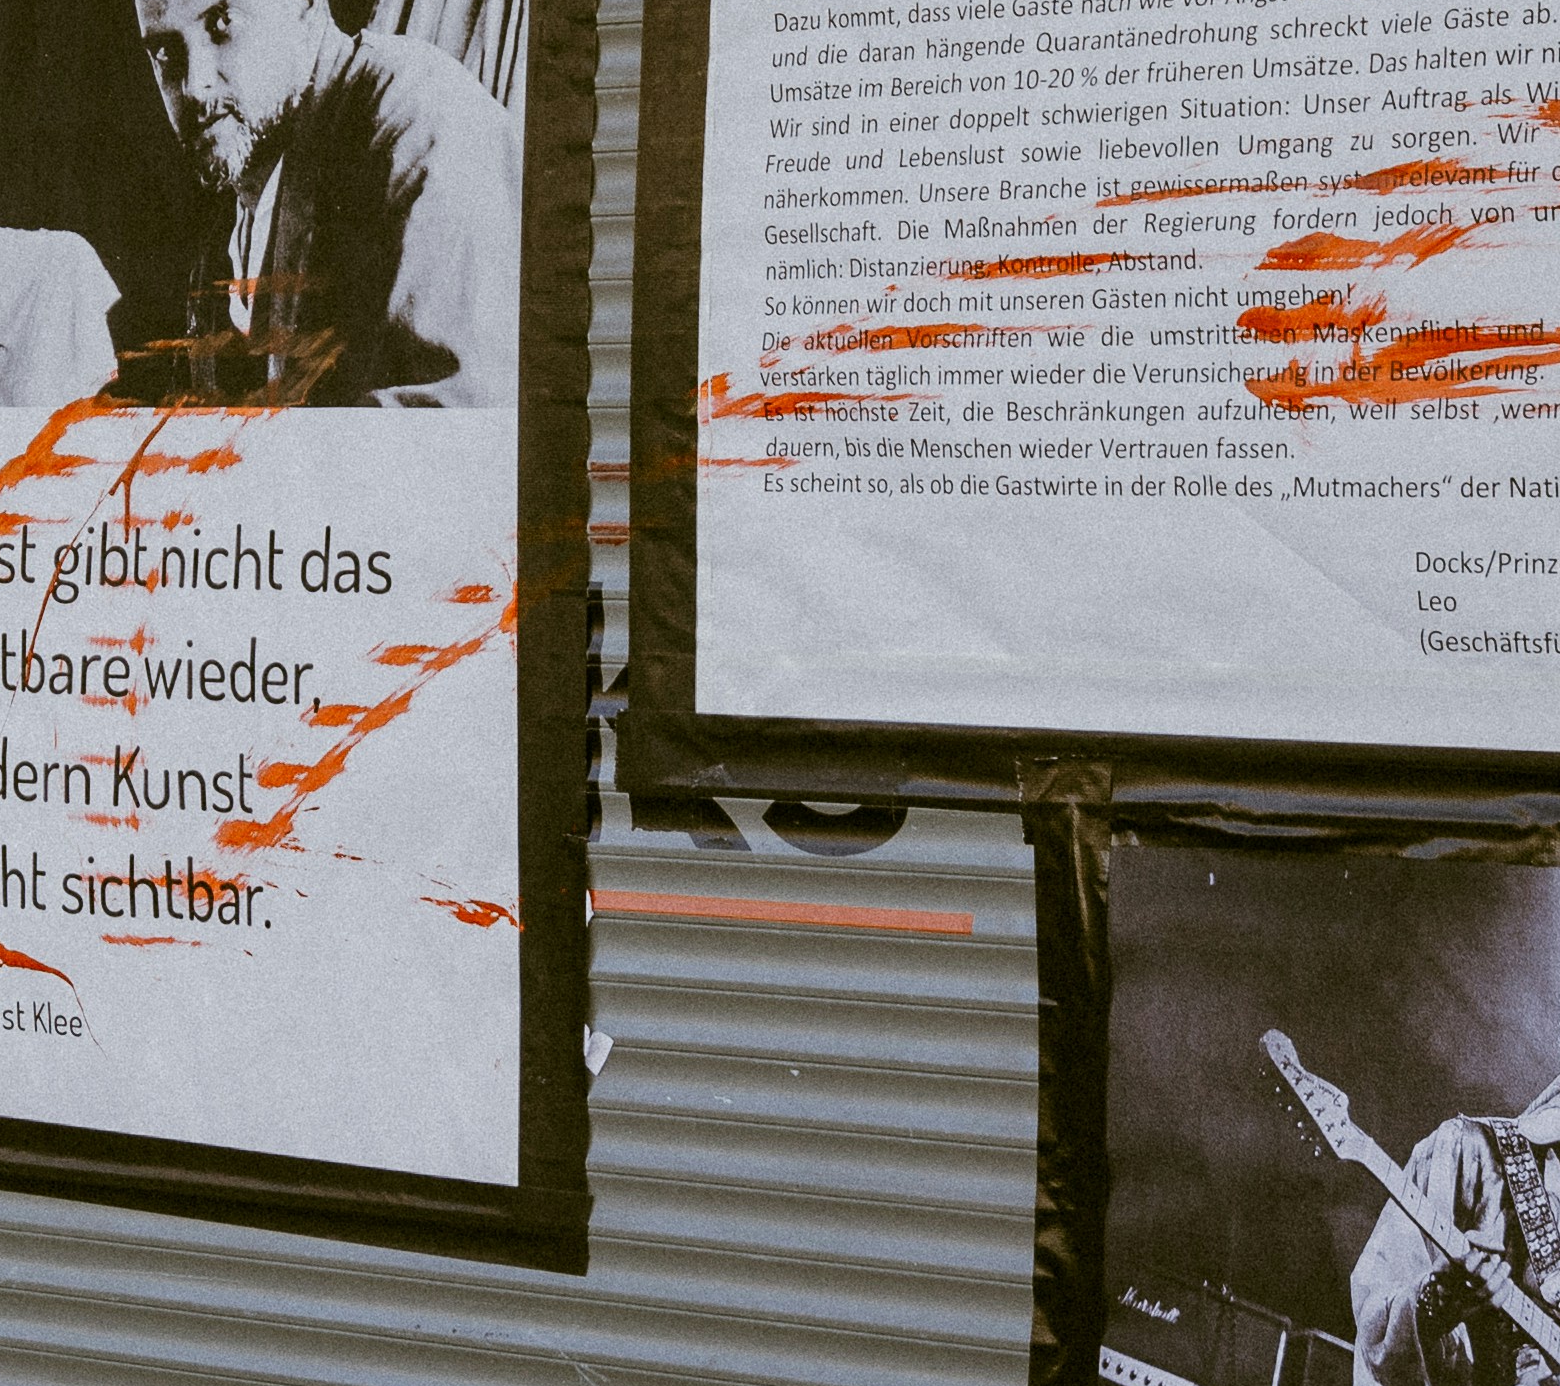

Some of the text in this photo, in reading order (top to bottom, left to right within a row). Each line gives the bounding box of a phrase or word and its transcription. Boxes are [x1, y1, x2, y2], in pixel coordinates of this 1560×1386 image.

[763, 472, 785, 493] Es
[790, 471, 862, 494] scheint
[867, 477, 894, 497] so,
[899, 472, 925, 495] als
[929, 473, 955, 495] ob
[959, 473, 990, 496] die
[995, 474, 1098, 497] Gastwirte
[1104, 475, 1124, 497] in
[1130, 474, 1167, 498] der
[1173, 474, 1228, 498] Rolle
[1234, 474, 1274, 498] des
[1459, 474, 1501, 499] der
[51, 521, 149, 605] gibt
[160, 523, 285, 592] nicht
[299, 525, 394, 596] das
[1416, 590, 1458, 613] Leo
[143, 636, 322, 713] wieder,
[111, 744, 254, 815] Kunst
[61, 853, 273, 930] sichtbar.
[32, 1001, 84, 1039] Klee
